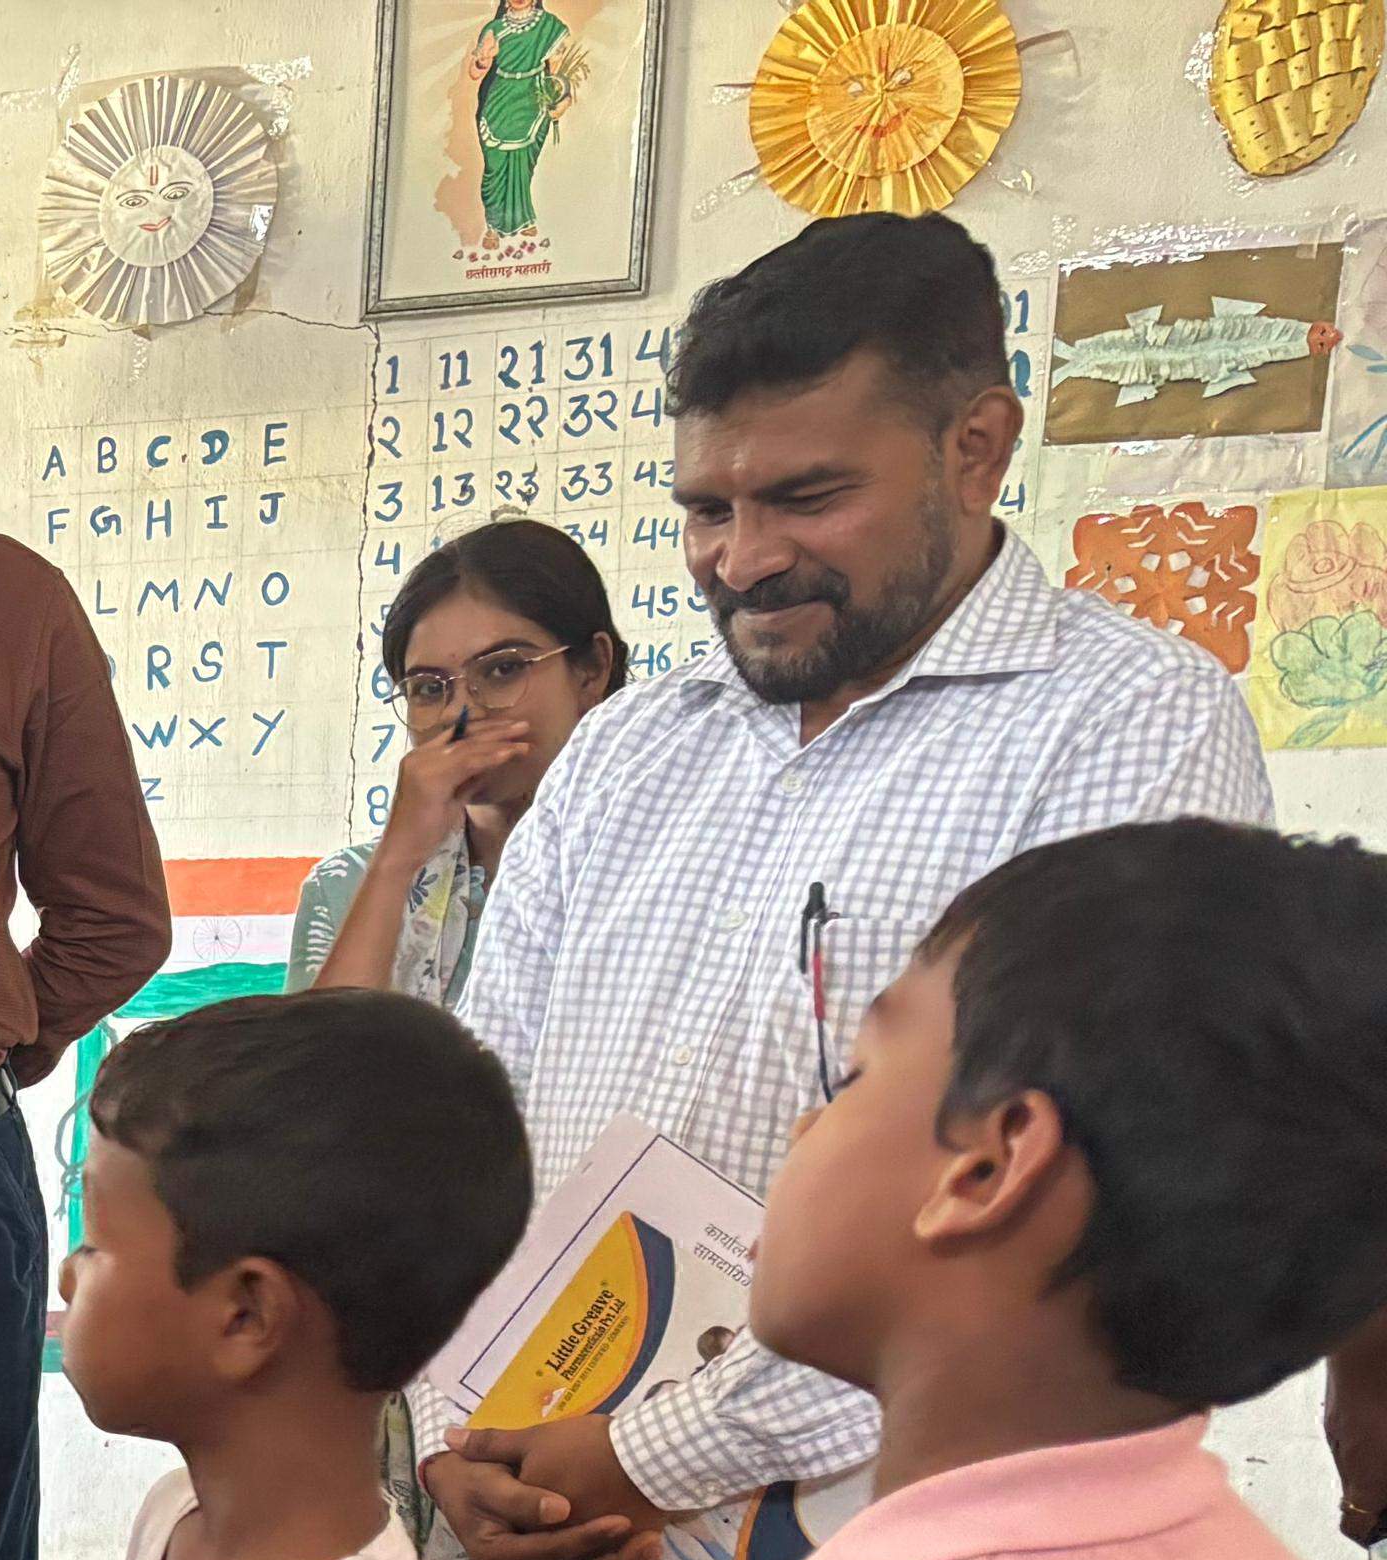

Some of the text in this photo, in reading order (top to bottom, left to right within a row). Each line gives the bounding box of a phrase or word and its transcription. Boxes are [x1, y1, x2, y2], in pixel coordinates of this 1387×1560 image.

[514, 259, 552, 275] महतारी
[386, 355, 399, 394] 1
[439, 350, 471, 390] 11
[498, 340, 545, 389] 21
[564, 333, 613, 381] 31
[636, 327, 675, 373] 4
[378, 416, 402, 458] 2
[432, 408, 473, 452] 12
[499, 395, 548, 445] 22
[564, 389, 618, 437] 32
[631, 387, 662, 428] 4
[42, 422, 288, 481] A B C D E
[374, 461, 675, 522] 3 13 23 33 43
[48, 492, 285, 544] F G H I J
[375, 540, 401, 575] 4
[563, 520, 608, 547] 34
[632, 516, 681, 550] 44
[95, 572, 289, 616] L M N O
[632, 584, 679, 619] 45
[147, 645, 172, 690] R
[192, 641, 223, 682] S
[256, 641, 287, 679] T
[371, 660, 393, 700] 6
[629, 642, 673, 676] 46
[132, 710, 285, 756] W X Y
[371, 724, 395, 763] 7
[141, 778, 165, 800] Z
[367, 785, 390, 825] 8
[704, 1223, 753, 1260] कार्याल
[545, 1335, 580, 1372] Little
[571, 1289, 615, 1337] Greave
